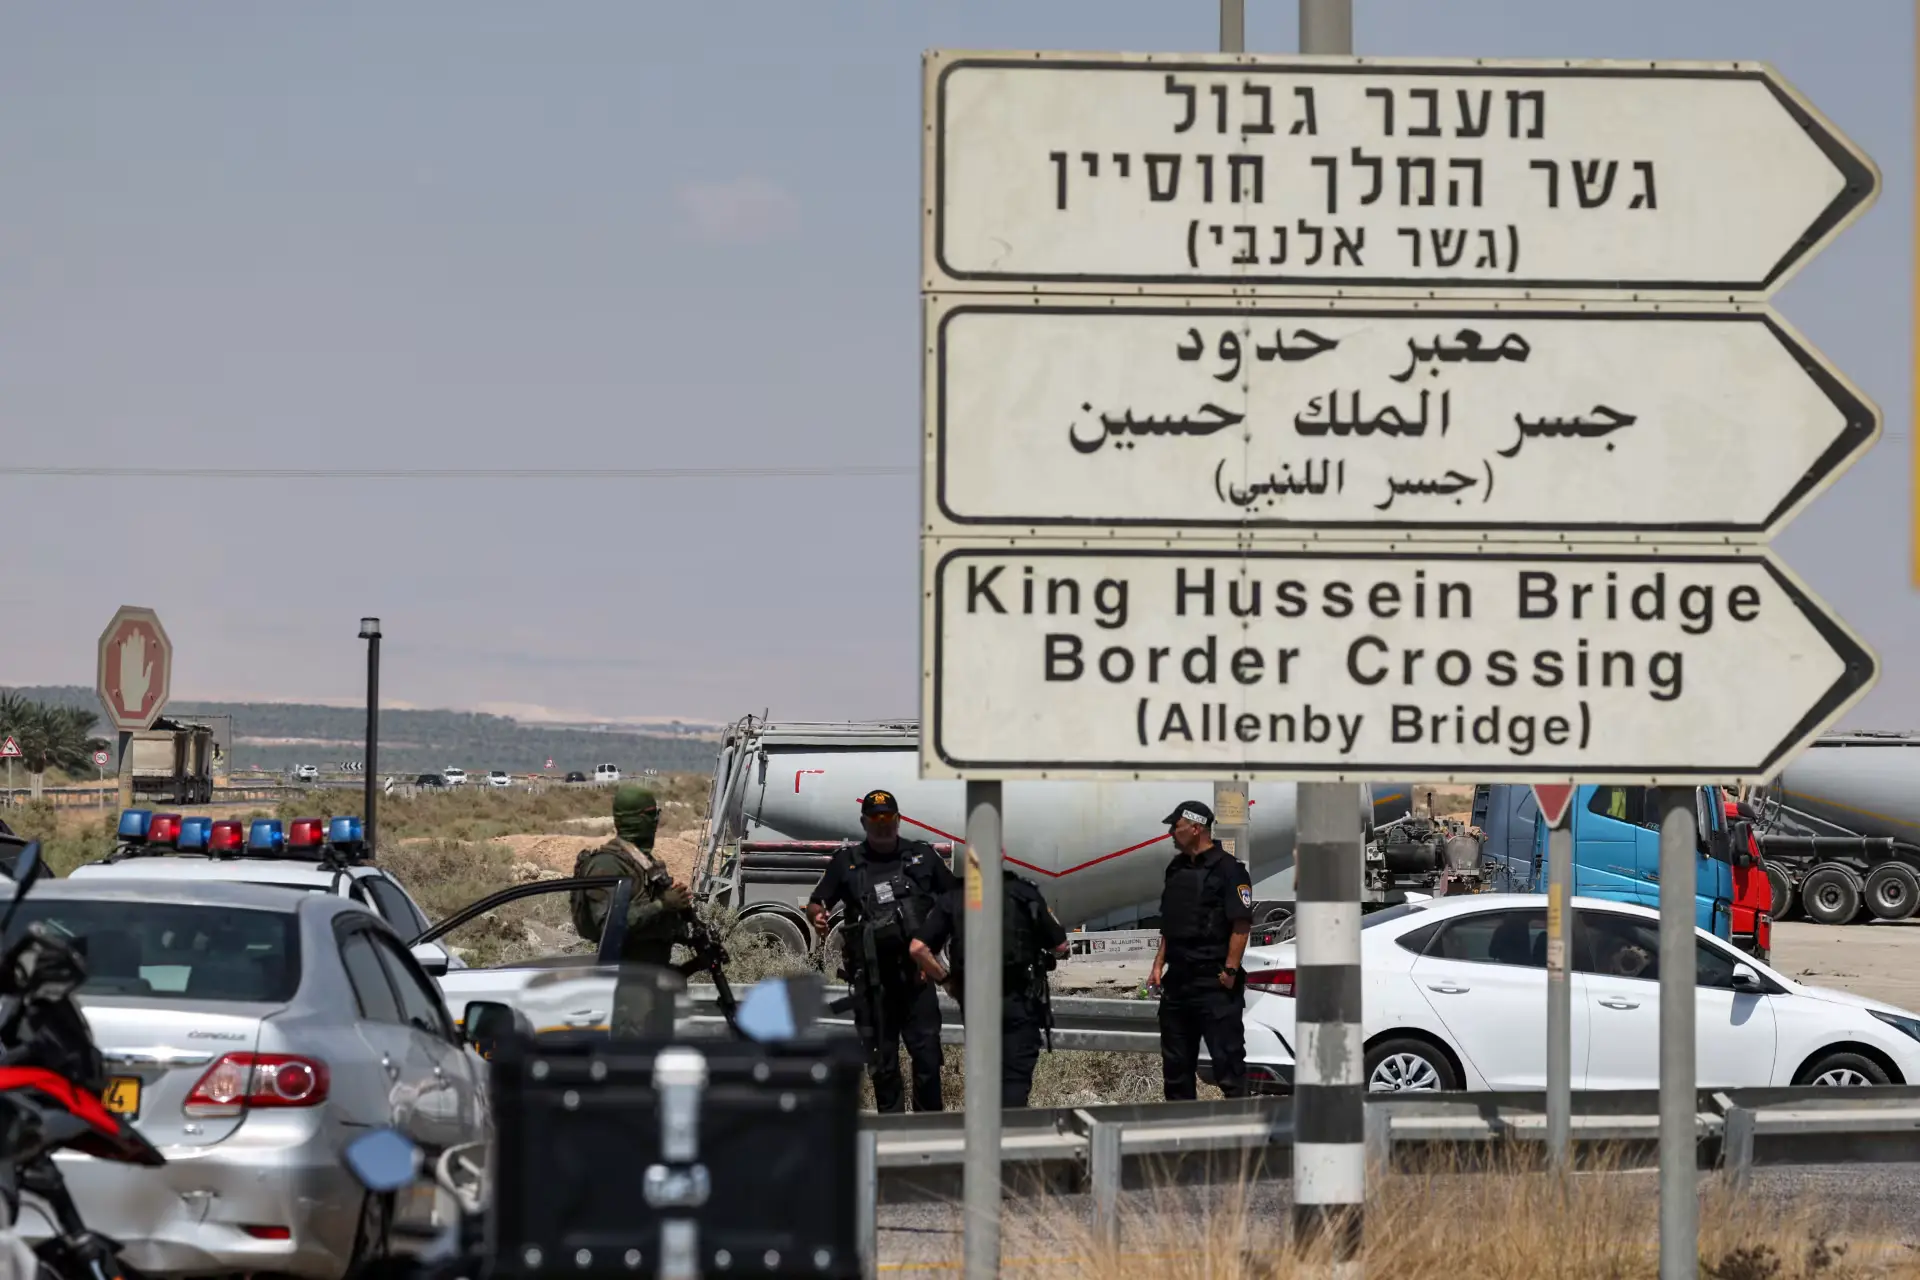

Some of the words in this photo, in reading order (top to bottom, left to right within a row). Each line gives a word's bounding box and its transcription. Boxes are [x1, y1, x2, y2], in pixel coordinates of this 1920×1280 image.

[1164, 75, 1319, 137] גבול
[1366, 87, 1546, 139] מעבר
[1049, 151, 1264, 210] חוסיין
[1310, 146, 1483, 214] המלך
[1529, 159, 1657, 210] גשר
[1187, 218, 1365, 268] אלנבי)
[1397, 224, 1519, 273] (גשר
[1177, 327, 1339, 383] حدود
[1389, 328, 1531, 383] معبر
[1069, 402, 1246, 454] حسين
[1293, 388, 1450, 438] الملك
[1497, 404, 1637, 458] جسر
[967, 565, 1129, 630] King
[1176, 567, 1476, 619] Hussein
[1518, 570, 1763, 634] Bridge
[1044, 633, 1300, 685] Border
[1346, 635, 1683, 701] Crossing
[1137, 697, 1363, 752] (Allenby
[1391, 700, 1591, 752] Bridge)
[1183, 810, 1207, 824] POLICE
